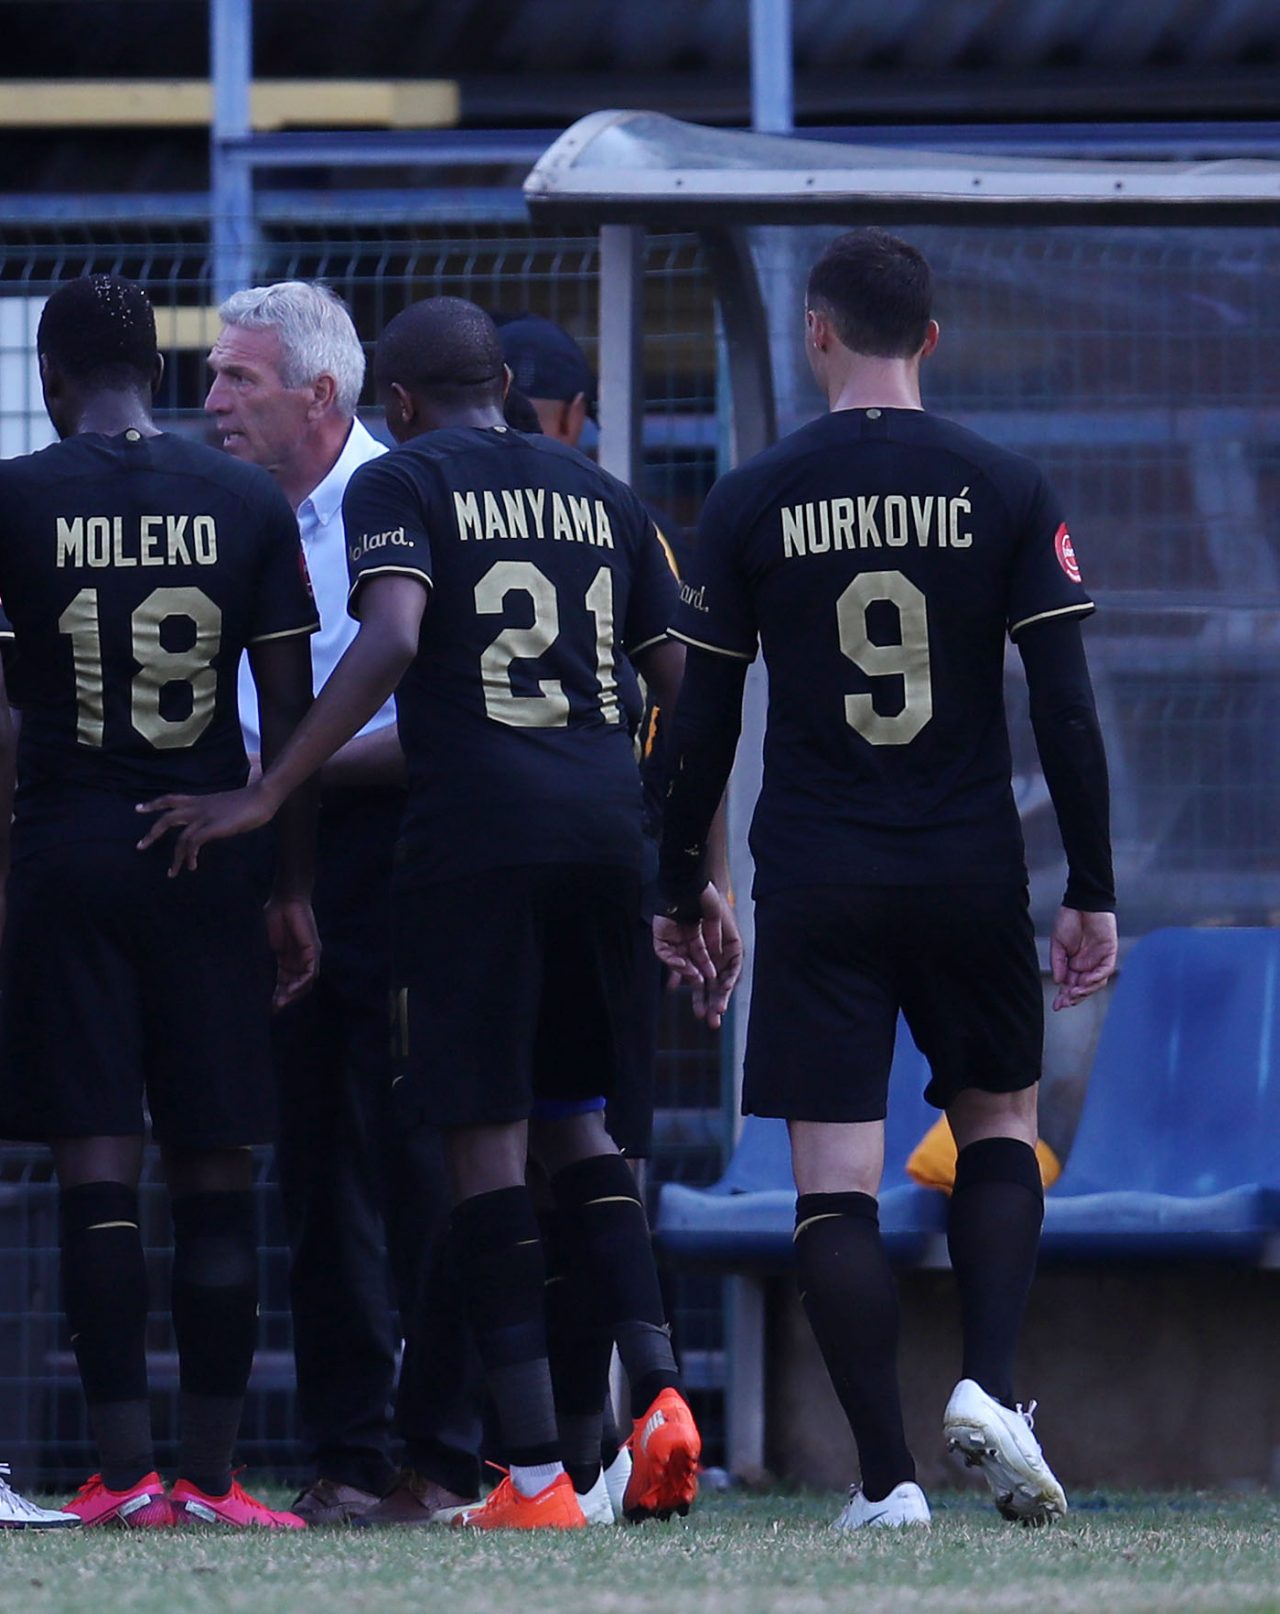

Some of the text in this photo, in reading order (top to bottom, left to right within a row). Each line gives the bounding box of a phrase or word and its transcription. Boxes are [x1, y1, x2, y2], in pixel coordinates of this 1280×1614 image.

[56, 515, 218, 567] MOLEKO
[453, 488, 615, 549] MANYAMA
[780, 487, 973, 558] NURKOVIĆ
[680, 584, 710, 612] ard.
[58, 586, 221, 749] 18
[474, 561, 620, 727] 21
[836, 570, 933, 745] 9
